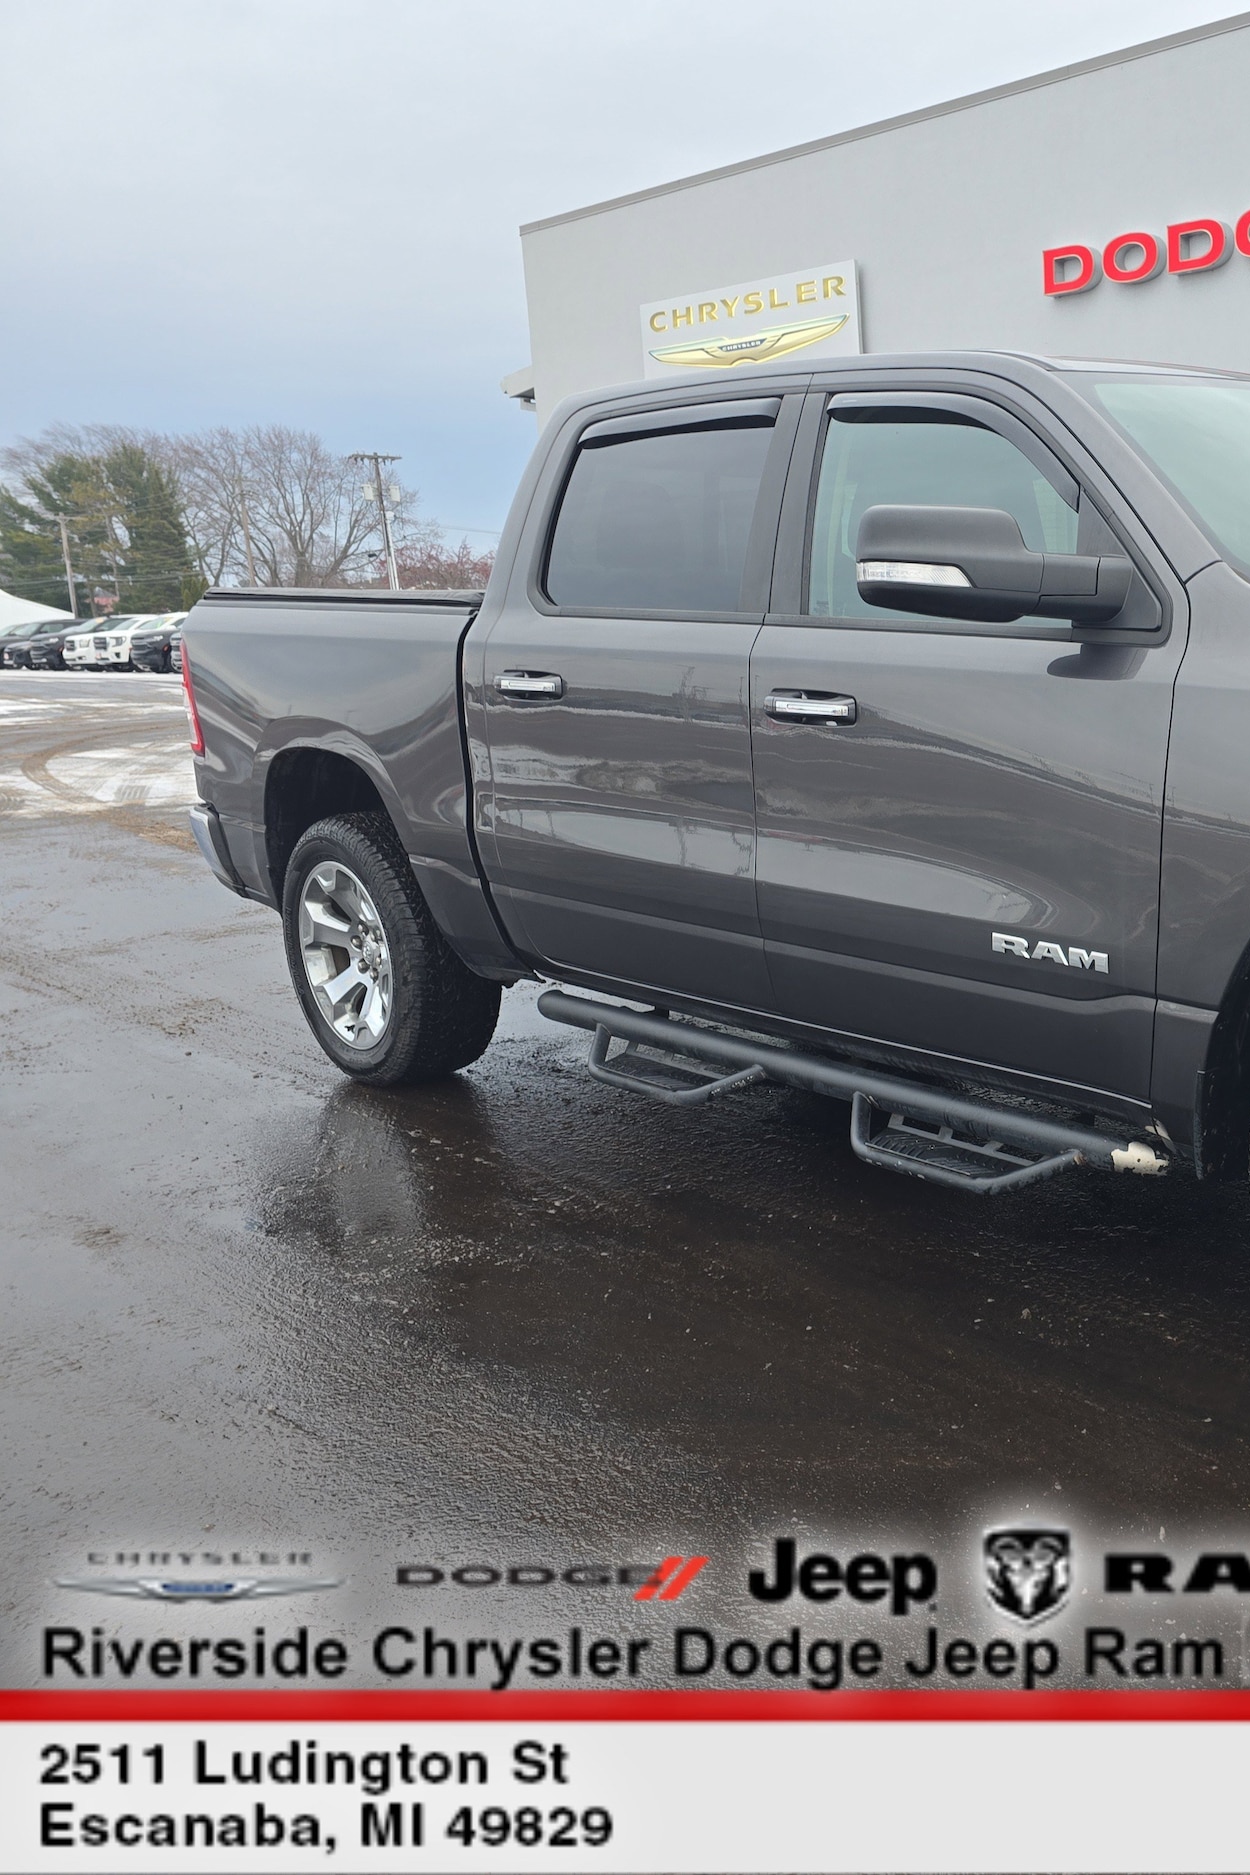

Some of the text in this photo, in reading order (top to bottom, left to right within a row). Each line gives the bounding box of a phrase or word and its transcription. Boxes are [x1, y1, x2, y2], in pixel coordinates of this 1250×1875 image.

[649, 276, 847, 333] CHRYSLER
[721, 340, 762, 352] CHRYSLER
[991, 931, 1109, 975] RAM
